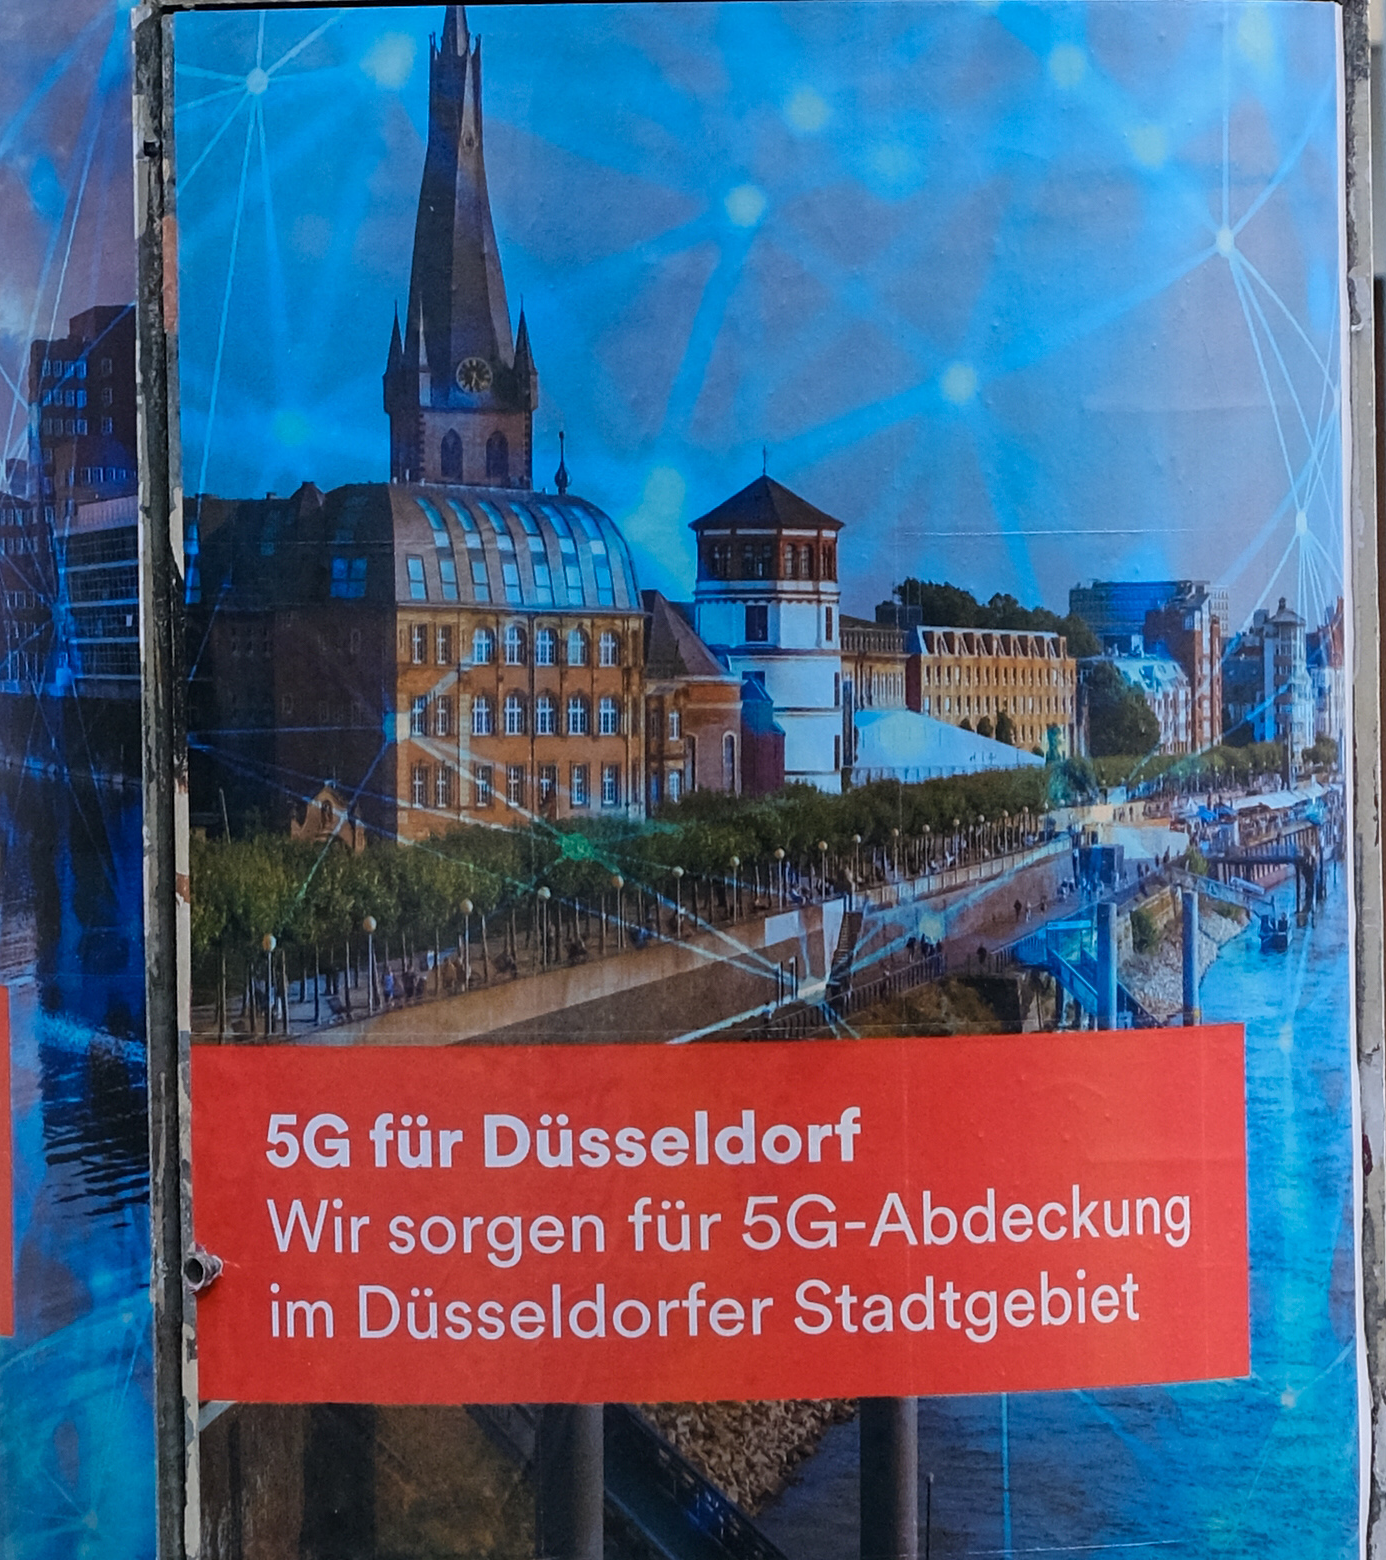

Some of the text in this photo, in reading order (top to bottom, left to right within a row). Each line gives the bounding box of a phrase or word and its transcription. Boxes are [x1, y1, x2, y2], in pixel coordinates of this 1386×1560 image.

[265, 1106, 862, 1169] 5G für Düsseldorf
[266, 1183, 1191, 1268] Wir sorgen für 5G-Abdeckung
[269, 1268, 1140, 1344] im Düsseldorfer Stadtgebiet
